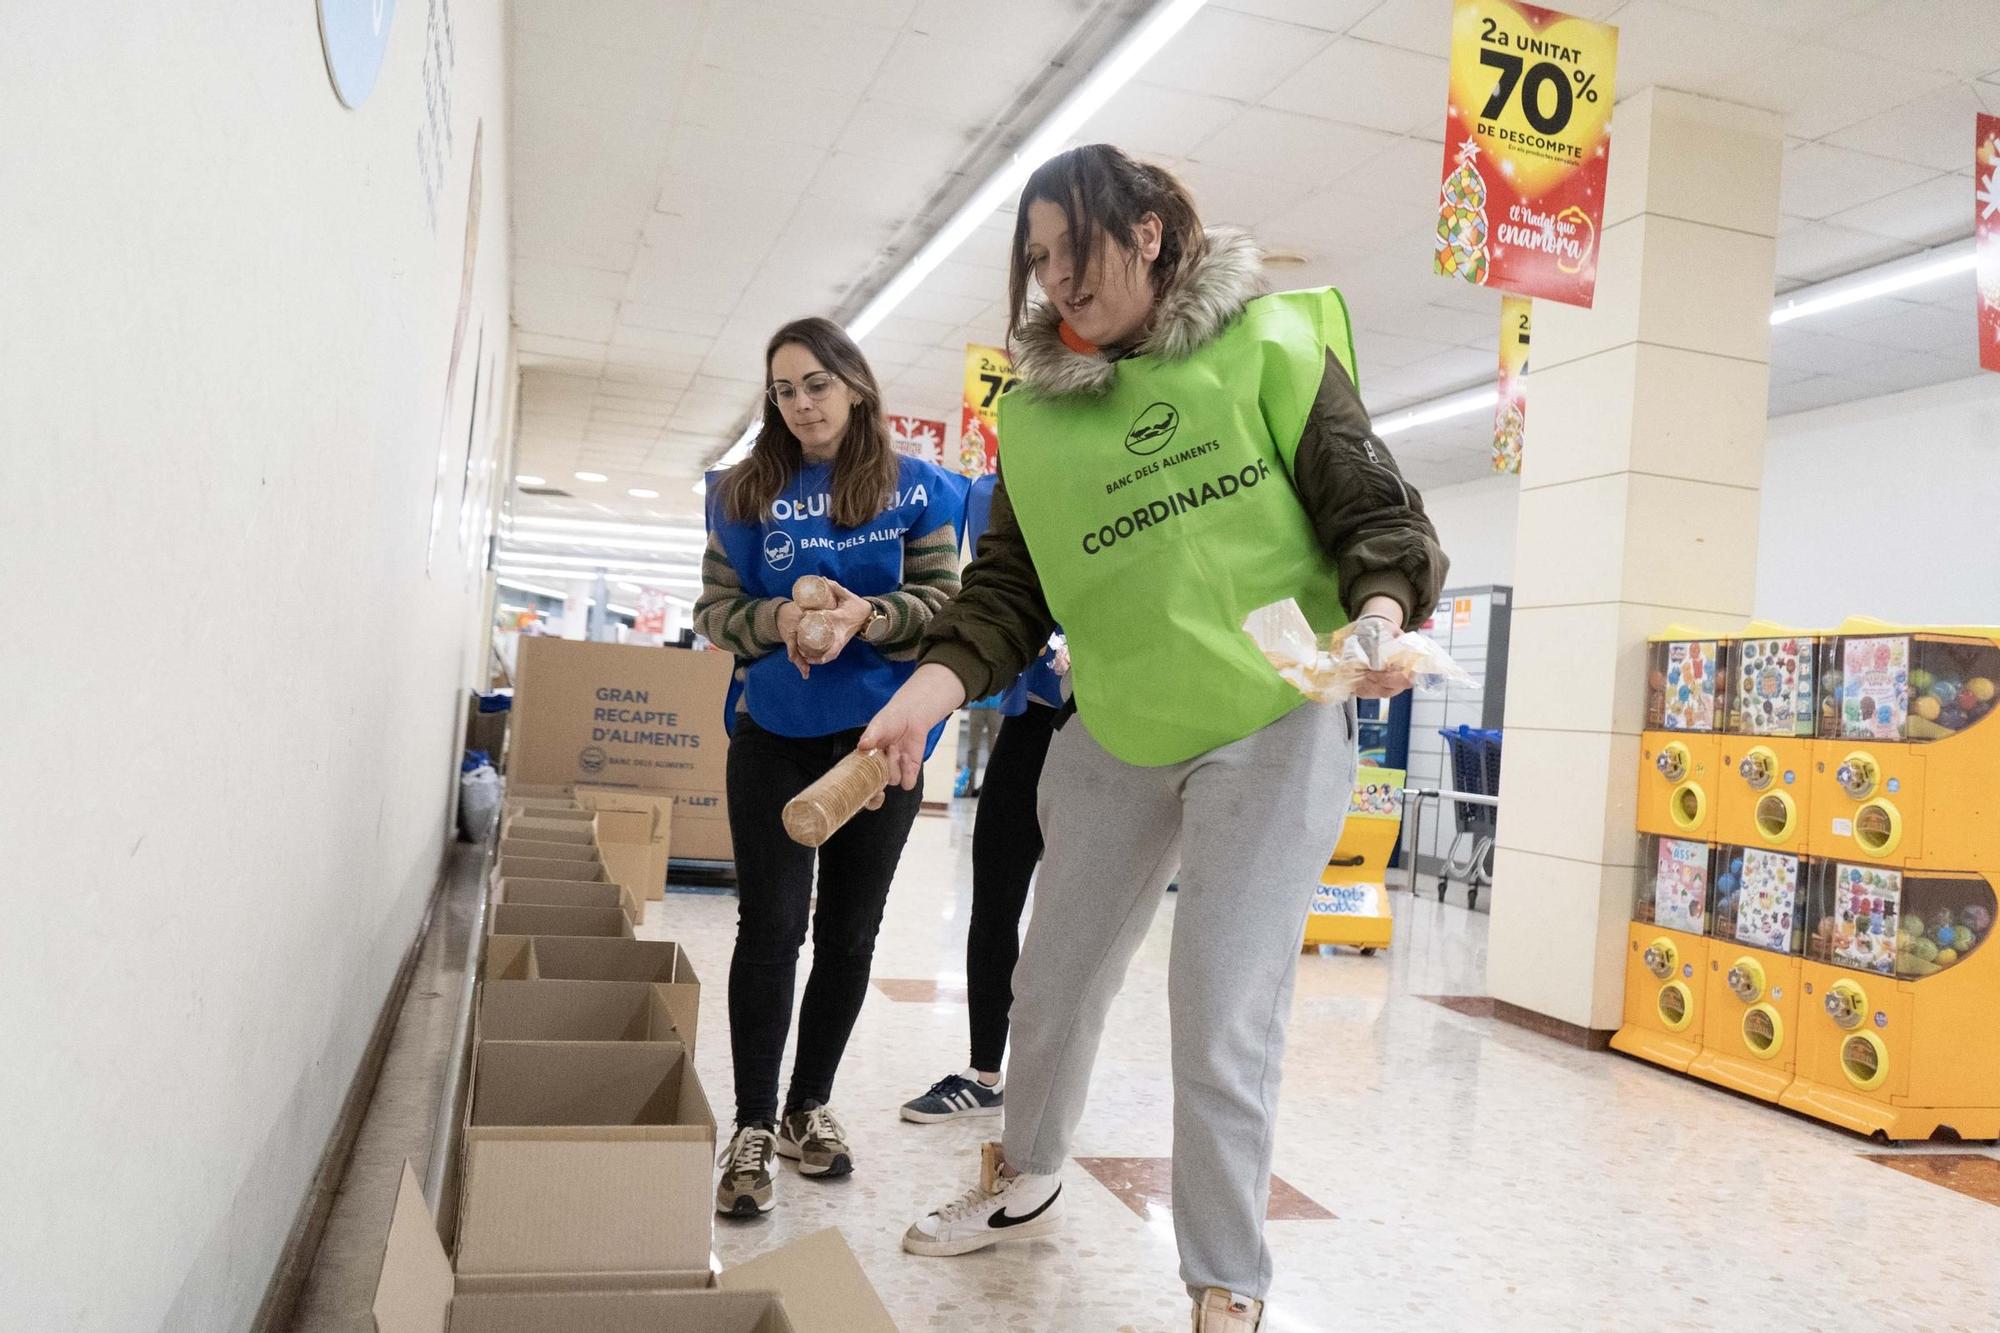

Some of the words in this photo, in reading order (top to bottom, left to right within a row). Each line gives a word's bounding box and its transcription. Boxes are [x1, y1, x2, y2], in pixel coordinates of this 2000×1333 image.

[1481, 17, 1509, 46] 2a
[1516, 35, 1582, 64] UNITAT
[1480, 47, 1598, 136] 70%
[1477, 123, 1495, 137] DE
[1500, 128, 1582, 158] DESCOMPTE
[1521, 206, 1556, 230] Nadal
[1557, 221, 1577, 237] que
[1497, 223, 1582, 259] enamora
[1519, 314, 1531, 330] 2
[1105, 473, 1133, 494] BANC
[1135, 462, 1159, 480] DELS
[1162, 439, 1220, 468] ALIMENTS
[800, 537, 835, 550] BANC
[837, 534, 866, 551] DELS
[596, 687, 649, 704] GRAN
[594, 707, 678, 726] RECAPTE
[592, 727, 700, 748] D'ALIMENTS
[688, 796, 719, 807] LLET
